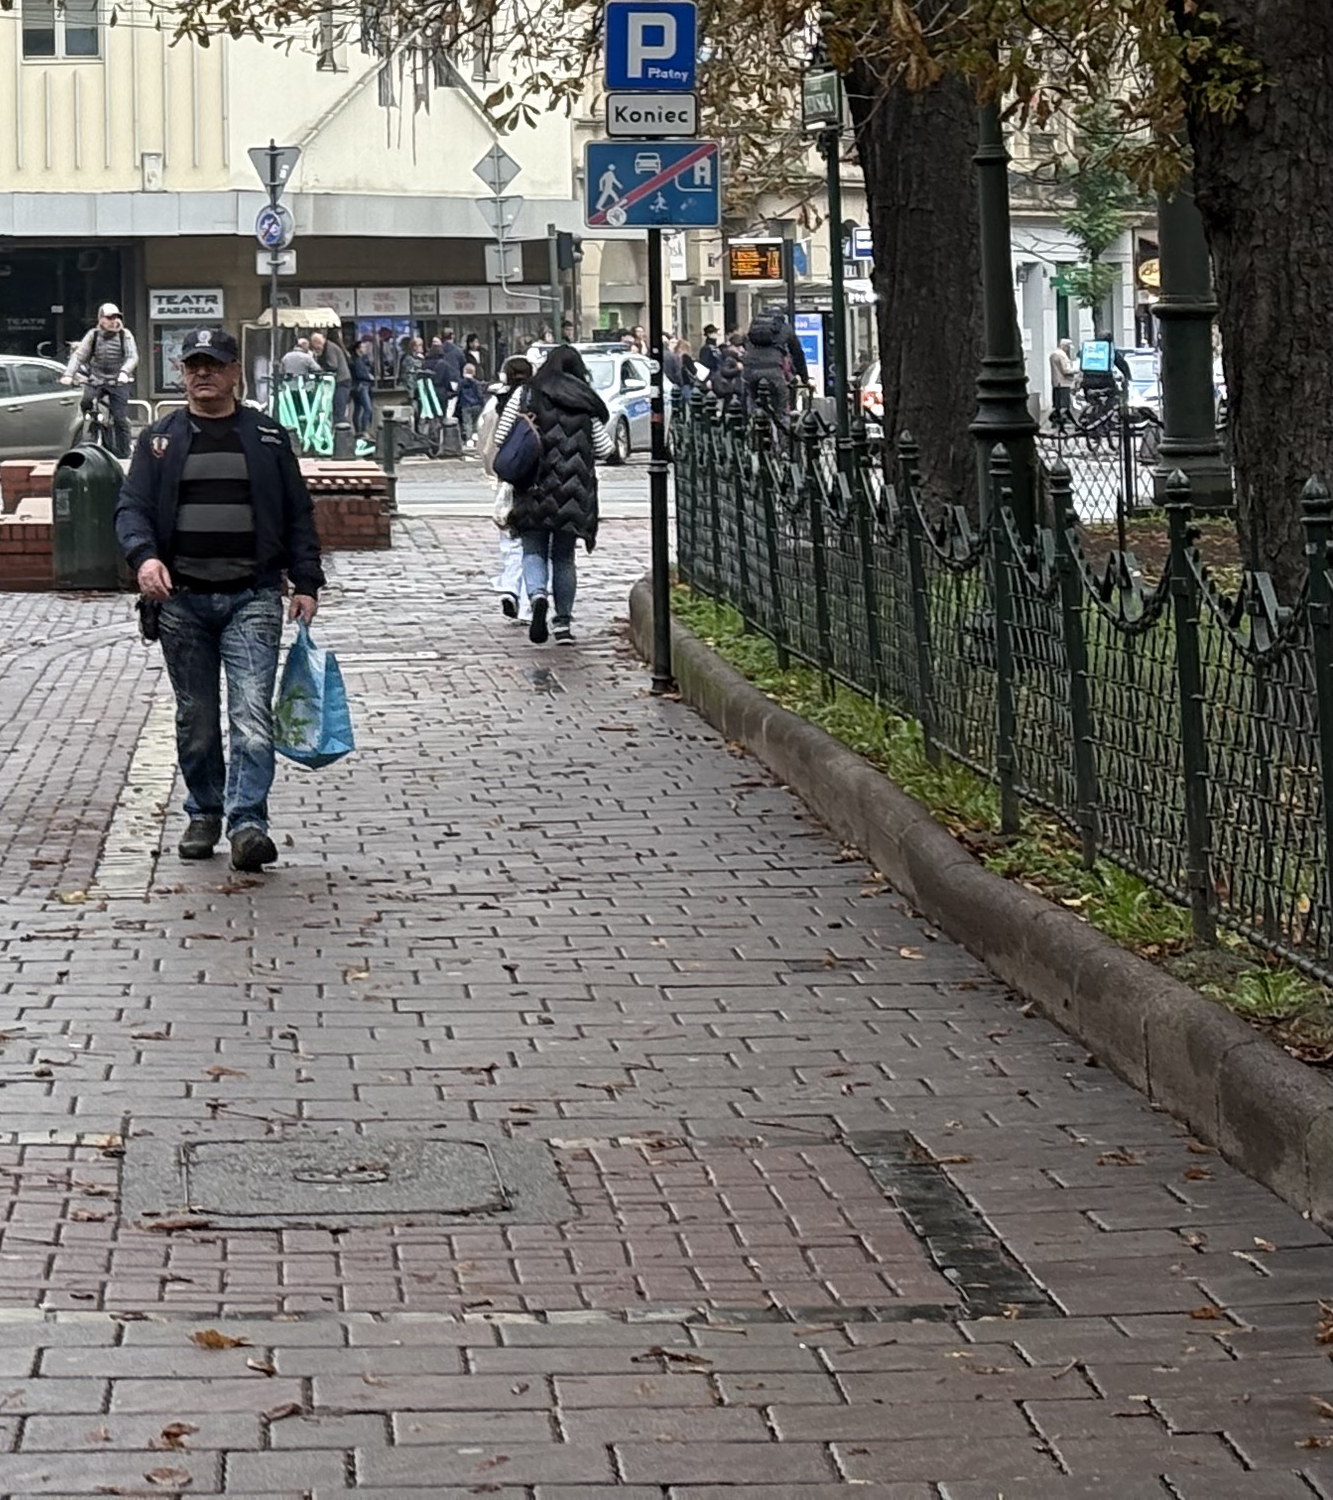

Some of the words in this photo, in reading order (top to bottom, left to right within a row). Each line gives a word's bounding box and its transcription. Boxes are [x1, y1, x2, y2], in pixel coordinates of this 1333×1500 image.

[627, 12, 677, 78] P
[614, 105, 688, 123] Koniec
[153, 295, 219, 305] TEATR
